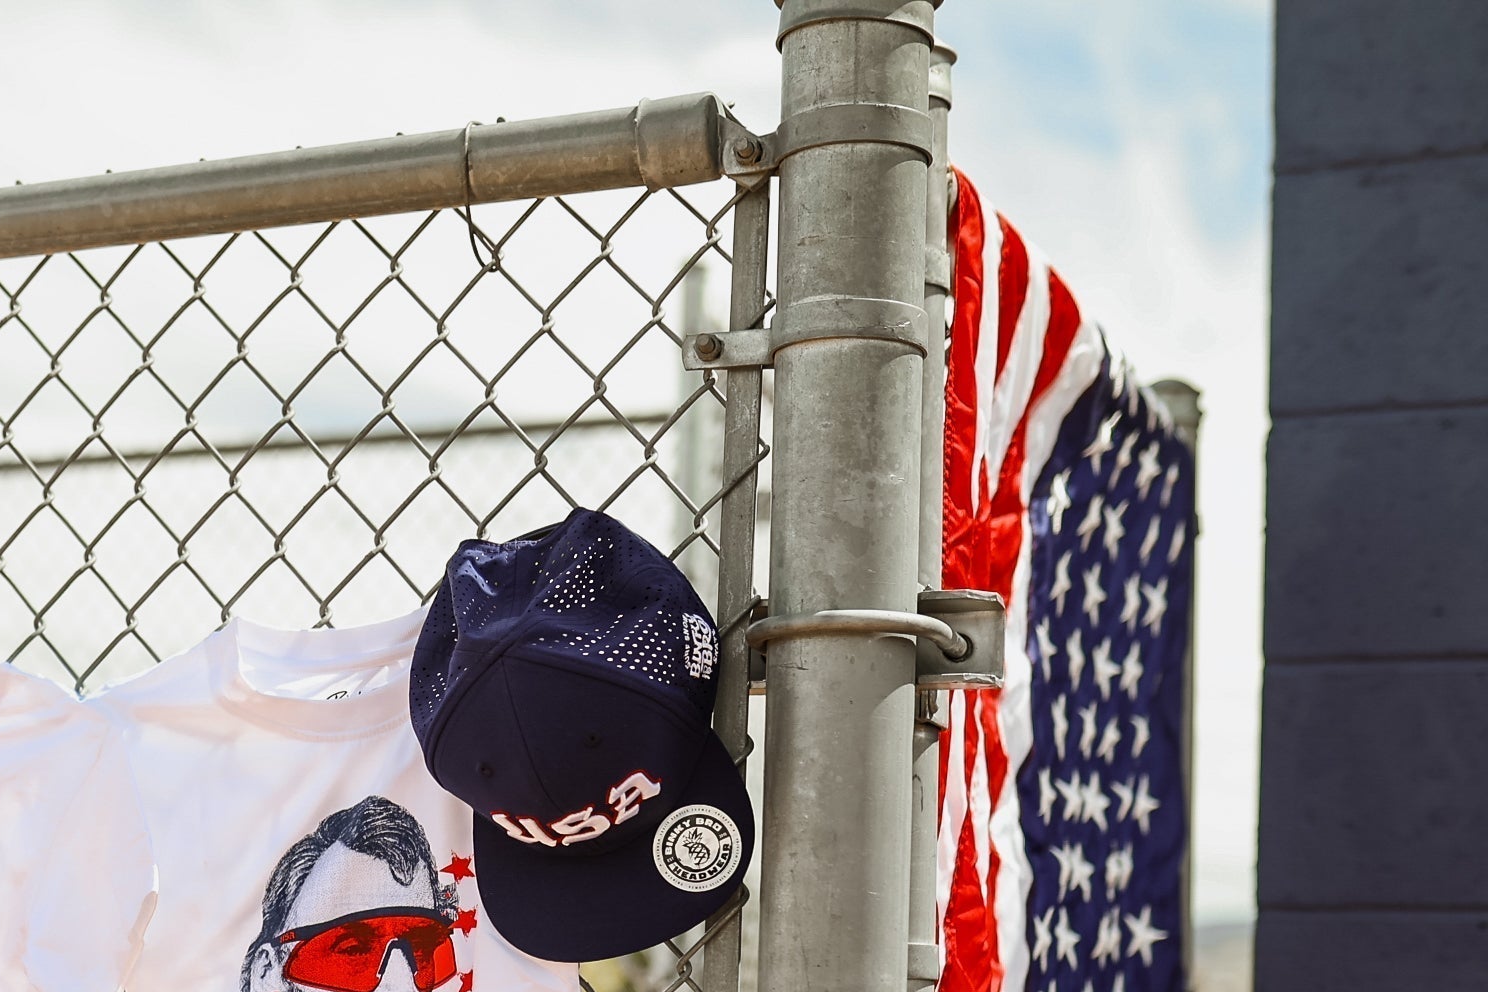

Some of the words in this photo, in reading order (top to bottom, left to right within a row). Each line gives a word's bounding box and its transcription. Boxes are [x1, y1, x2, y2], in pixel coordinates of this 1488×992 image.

[489, 769, 662, 848] USA
[665, 819, 691, 856] BINKY
[695, 817, 723, 832] BRO
[672, 843, 731, 880] HEADWEAR
